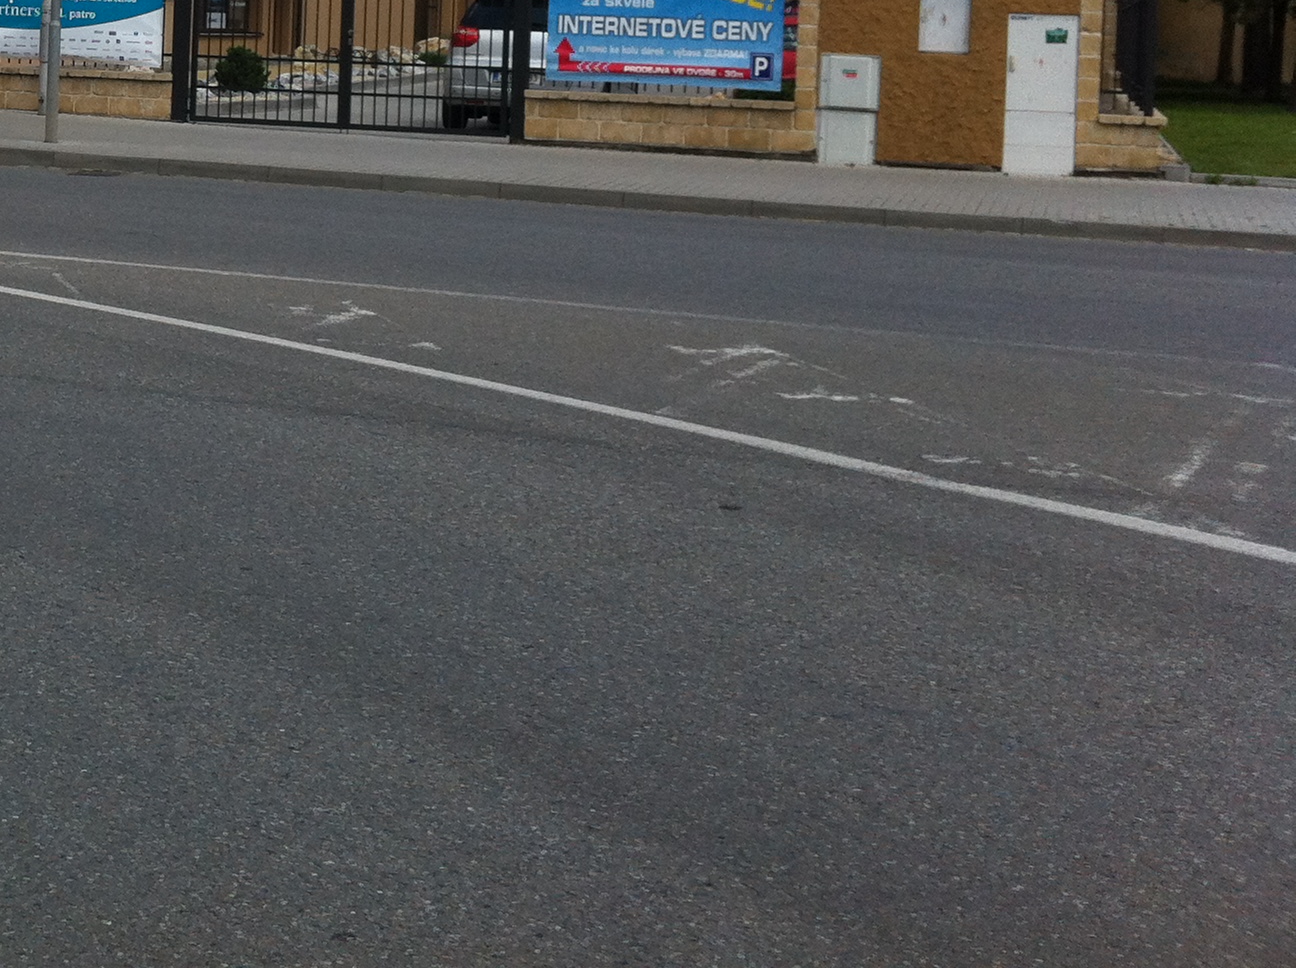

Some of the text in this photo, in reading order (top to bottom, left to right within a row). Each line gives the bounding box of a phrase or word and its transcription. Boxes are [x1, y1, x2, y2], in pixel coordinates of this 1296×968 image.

[69, 9, 96, 20] patro
[558, 13, 774, 42] INTERNETOVÉ CENY
[623, 65, 670, 75] PRODEJNA
[672, 66, 685, 75] VE
[686, 67, 717, 77] DVOŘE
[724, 69, 744, 78] 30m
[754, 57, 769, 77] P
